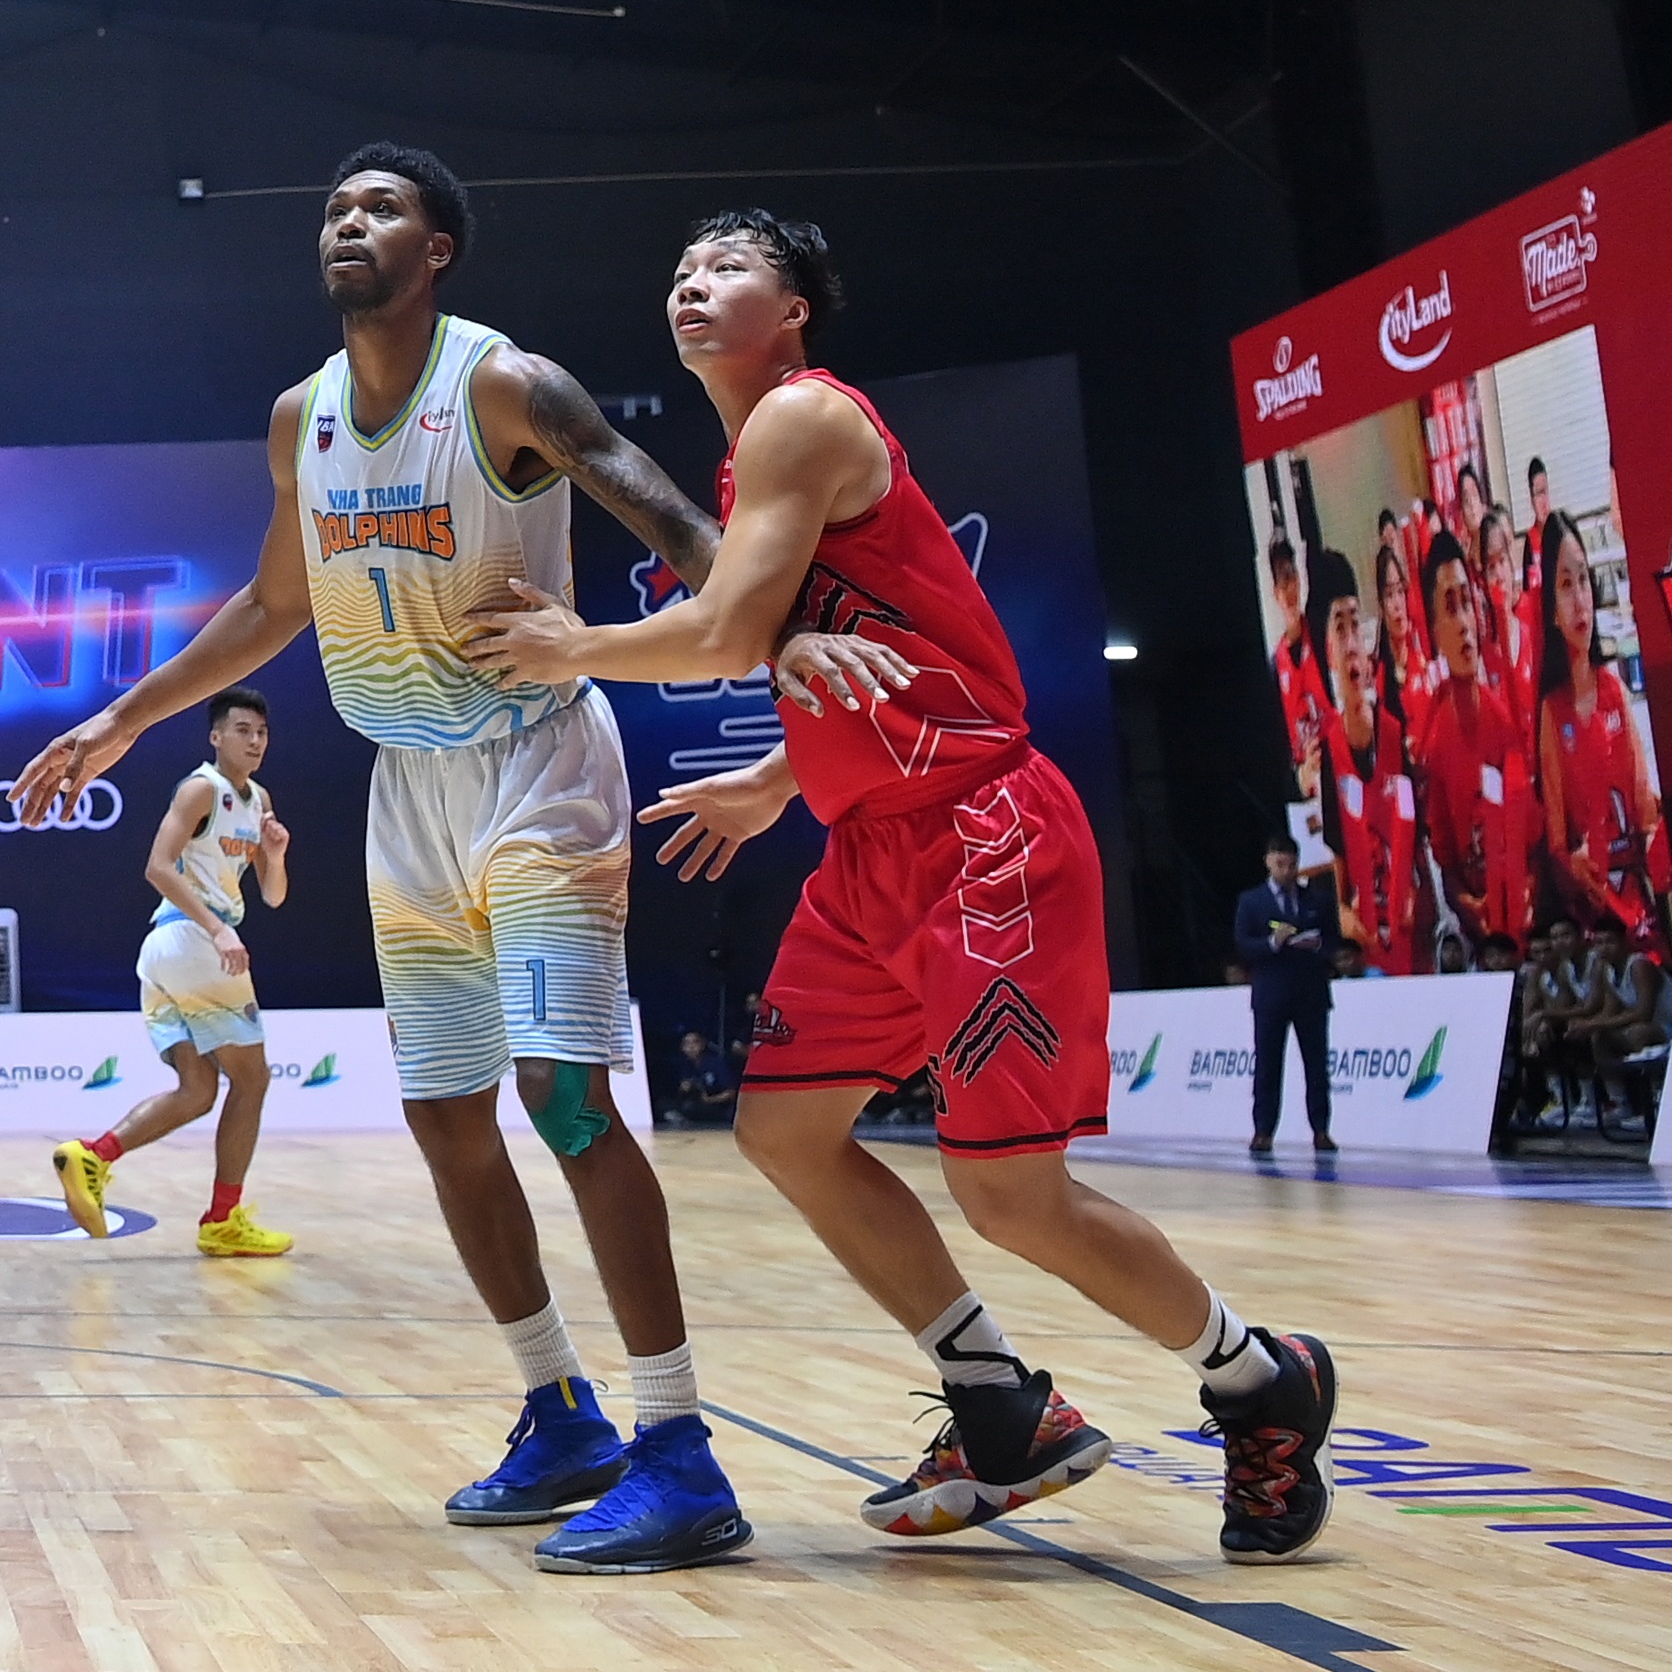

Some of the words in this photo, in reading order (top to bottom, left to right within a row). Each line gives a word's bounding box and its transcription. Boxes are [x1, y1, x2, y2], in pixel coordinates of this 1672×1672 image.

[1378, 269, 1453, 372] CityLand
[364, 484, 423, 508] TRANG
[311, 501, 456, 563] DOLPHINS
[368, 567, 397, 633] 1
[525, 959, 548, 1021] 1
